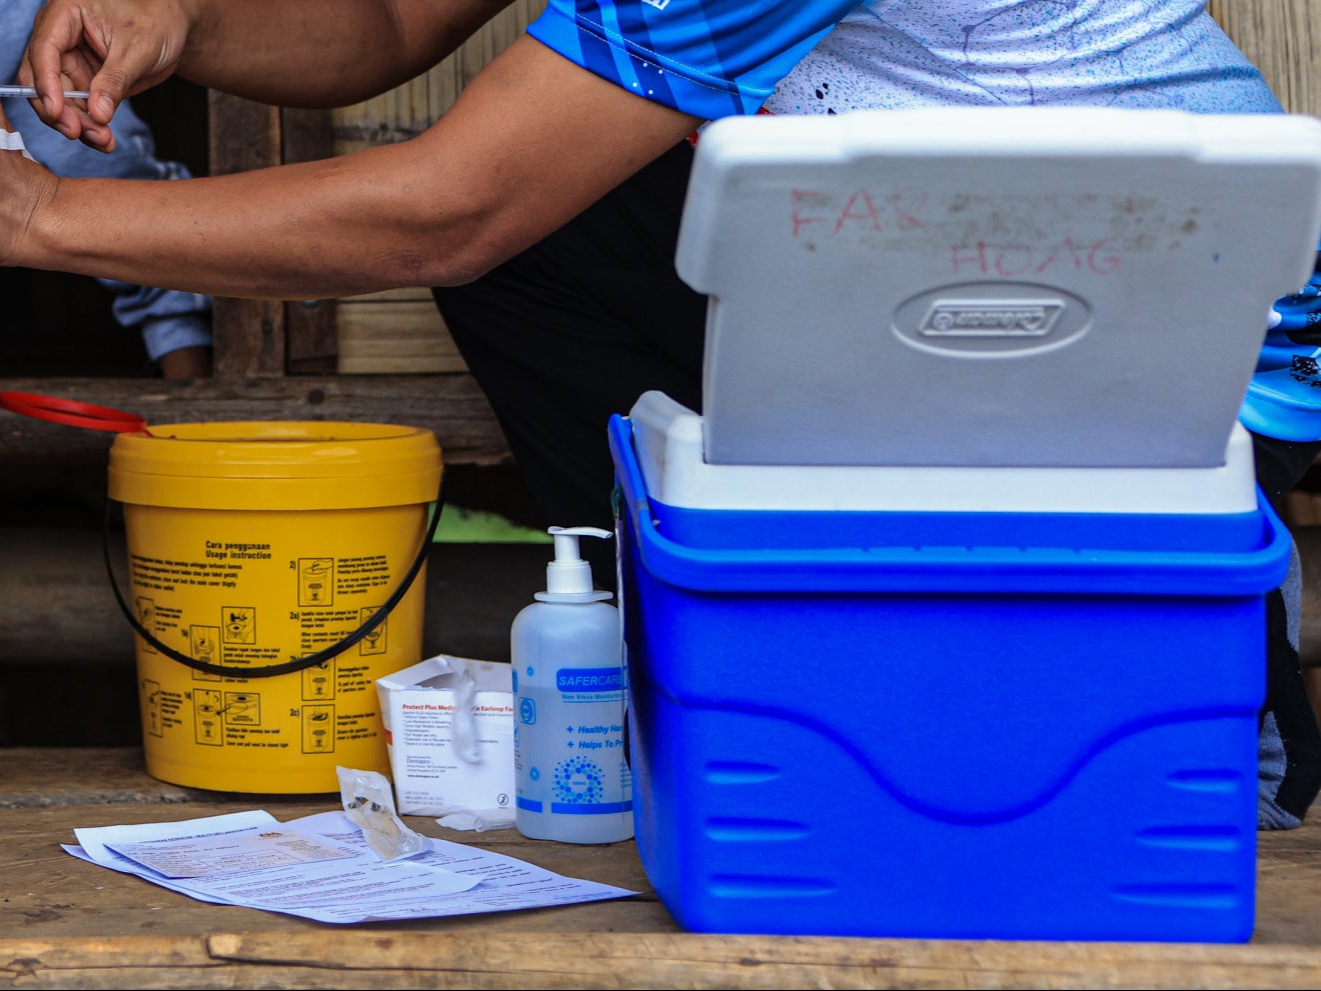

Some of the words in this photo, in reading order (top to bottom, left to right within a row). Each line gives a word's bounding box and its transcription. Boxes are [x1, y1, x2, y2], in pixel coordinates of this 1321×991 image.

[205, 540, 222, 549] Cara
[205, 549, 227, 560] Usage
[230, 550, 272, 559] instruction
[578, 725, 609, 735] Healthy
[579, 741, 602, 750] Helps
